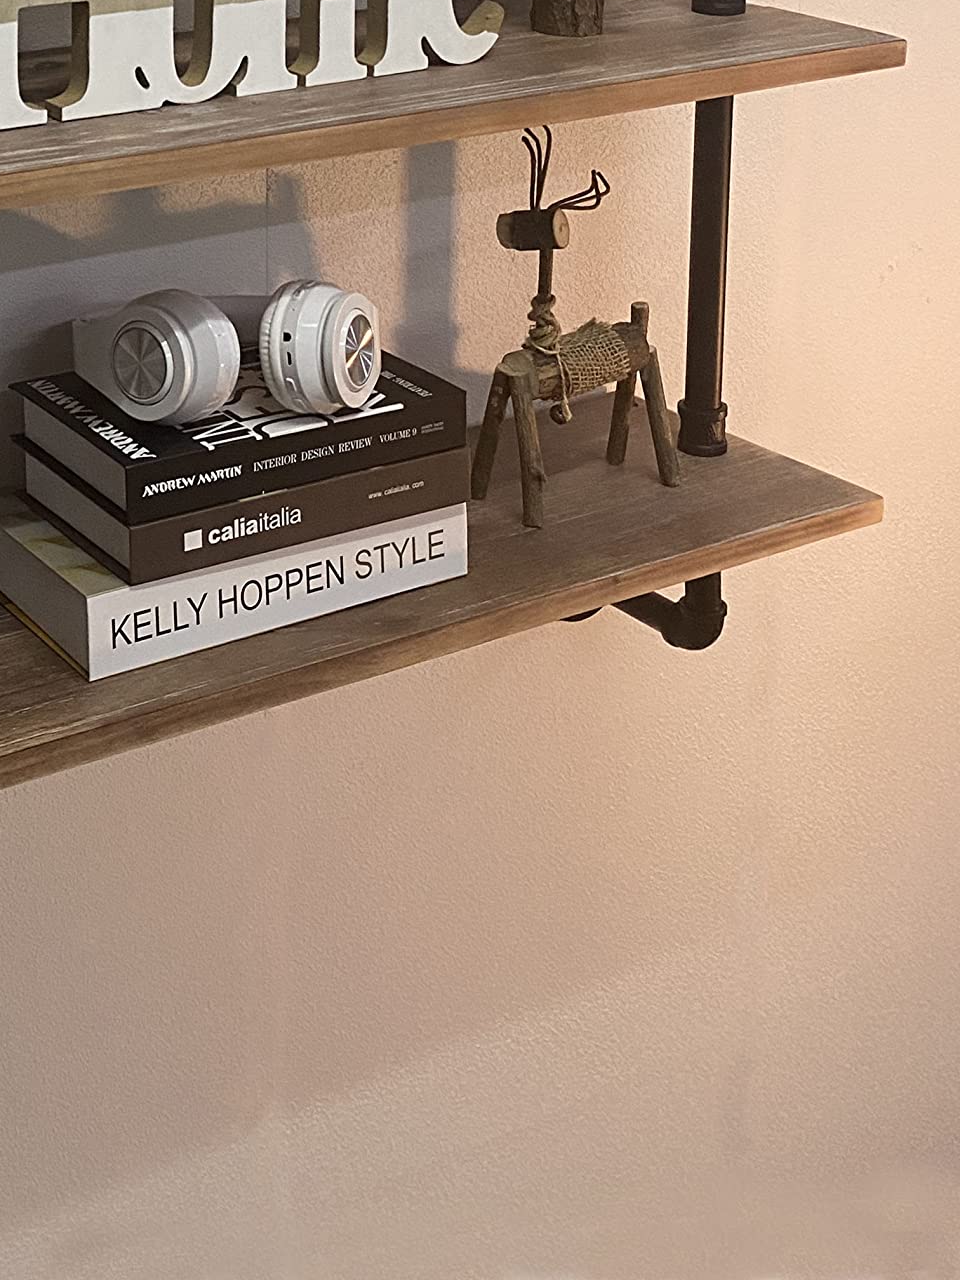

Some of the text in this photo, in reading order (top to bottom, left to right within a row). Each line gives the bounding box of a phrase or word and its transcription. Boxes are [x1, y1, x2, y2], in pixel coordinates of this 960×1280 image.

[142, 475, 197, 498] ANDREW
[196, 465, 243, 486] MARTIN
[253, 453, 297, 472] INTERIOR
[301, 445, 334, 462] DESIGN
[338, 436, 373, 453] REVIEW
[379, 428, 411, 443] VOLUME
[411, 427, 418, 436] 9
[208, 506, 302, 544] caliaitalia
[110, 529, 446, 650] KELLY HOPPEN STYLE
